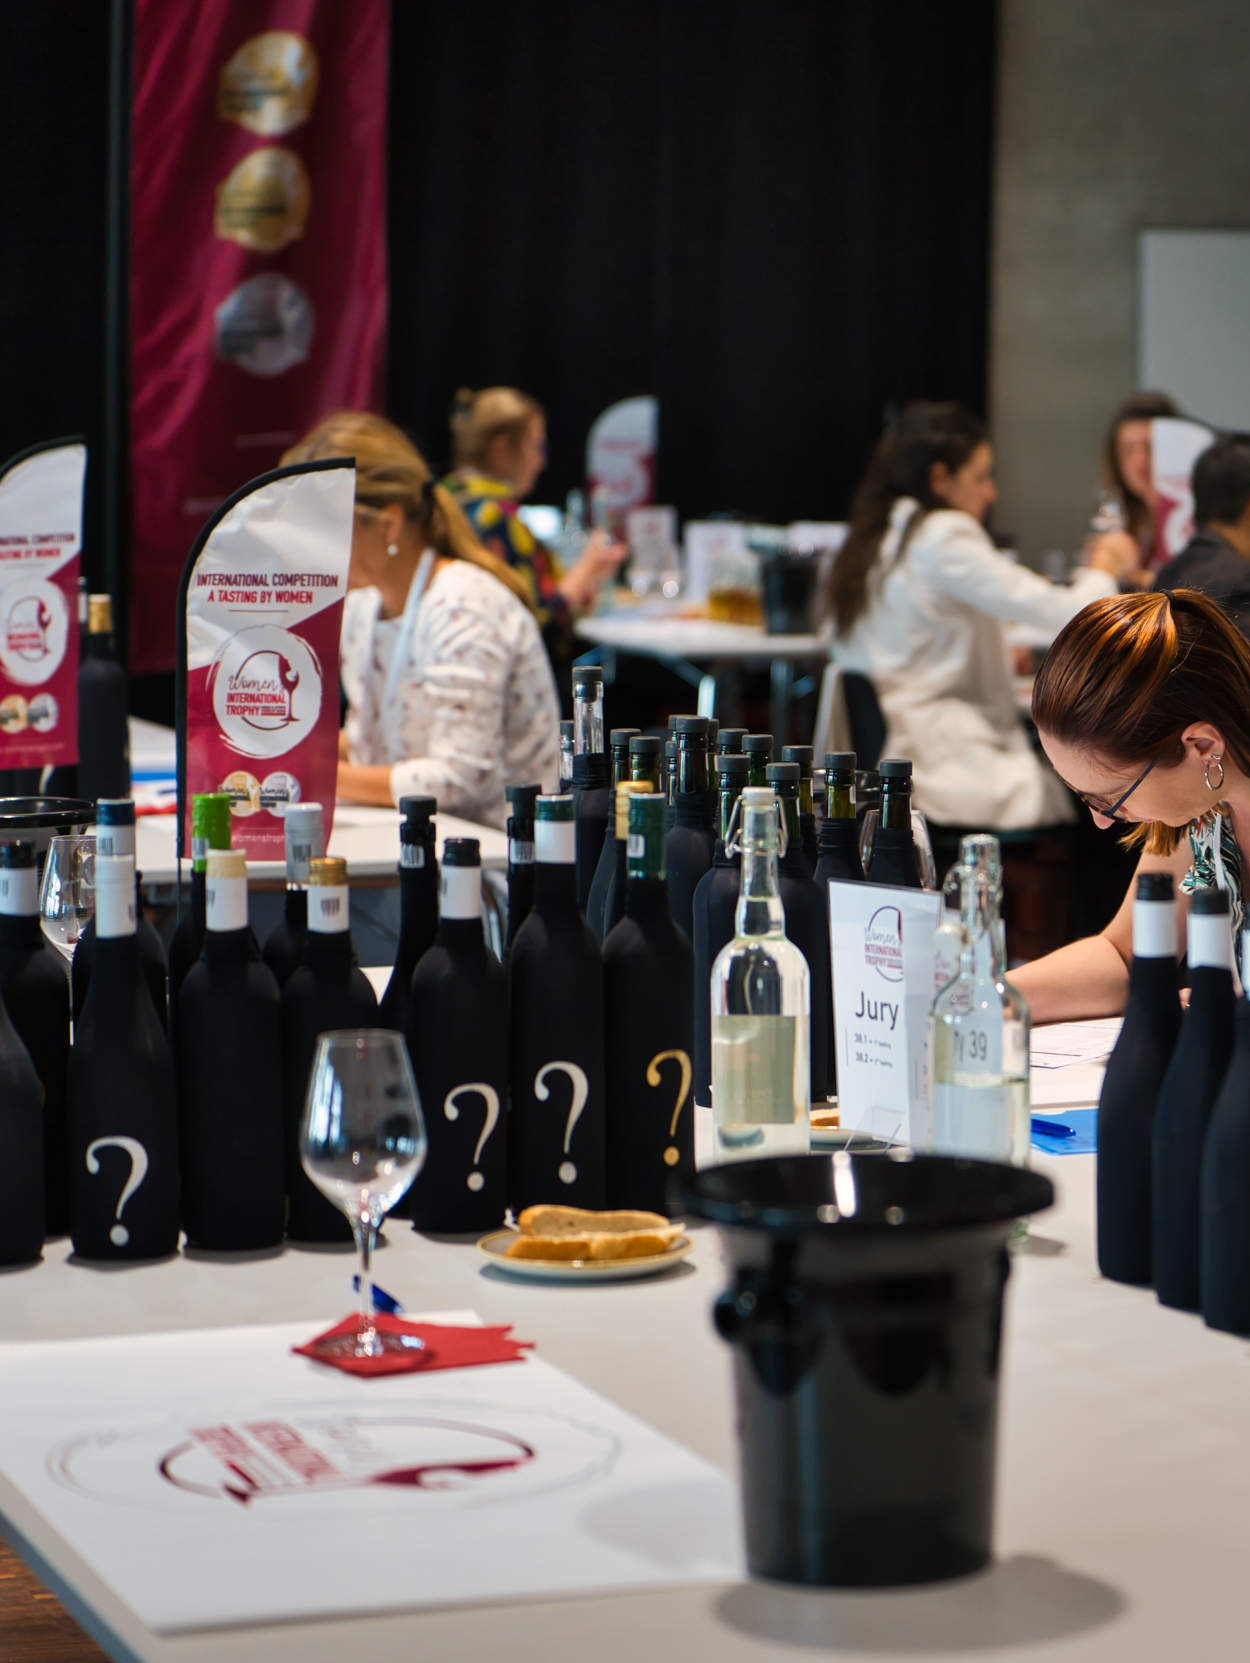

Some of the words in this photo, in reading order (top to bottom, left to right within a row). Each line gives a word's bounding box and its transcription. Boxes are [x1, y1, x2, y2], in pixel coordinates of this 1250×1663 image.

[197, 573, 270, 587] INTERNATIONAL
[272, 573, 339, 587] COMPETITION
[207, 590, 215, 602] A
[218, 590, 258, 603] TASTING
[260, 590, 273, 603] BY
[275, 591, 313, 604] WOMEN
[226, 692, 286, 704] INTERNATIONAL
[226, 705, 260, 716] TROPHY
[865, 943, 902, 957] INTERNATIONAL
[865, 954, 886, 967] TROPHY
[855, 990, 899, 1031] Jury
[854, 1033, 867, 1044] 38.1
[969, 1029, 987, 1061] 39
[855, 1052, 869, 1064] 38.2
